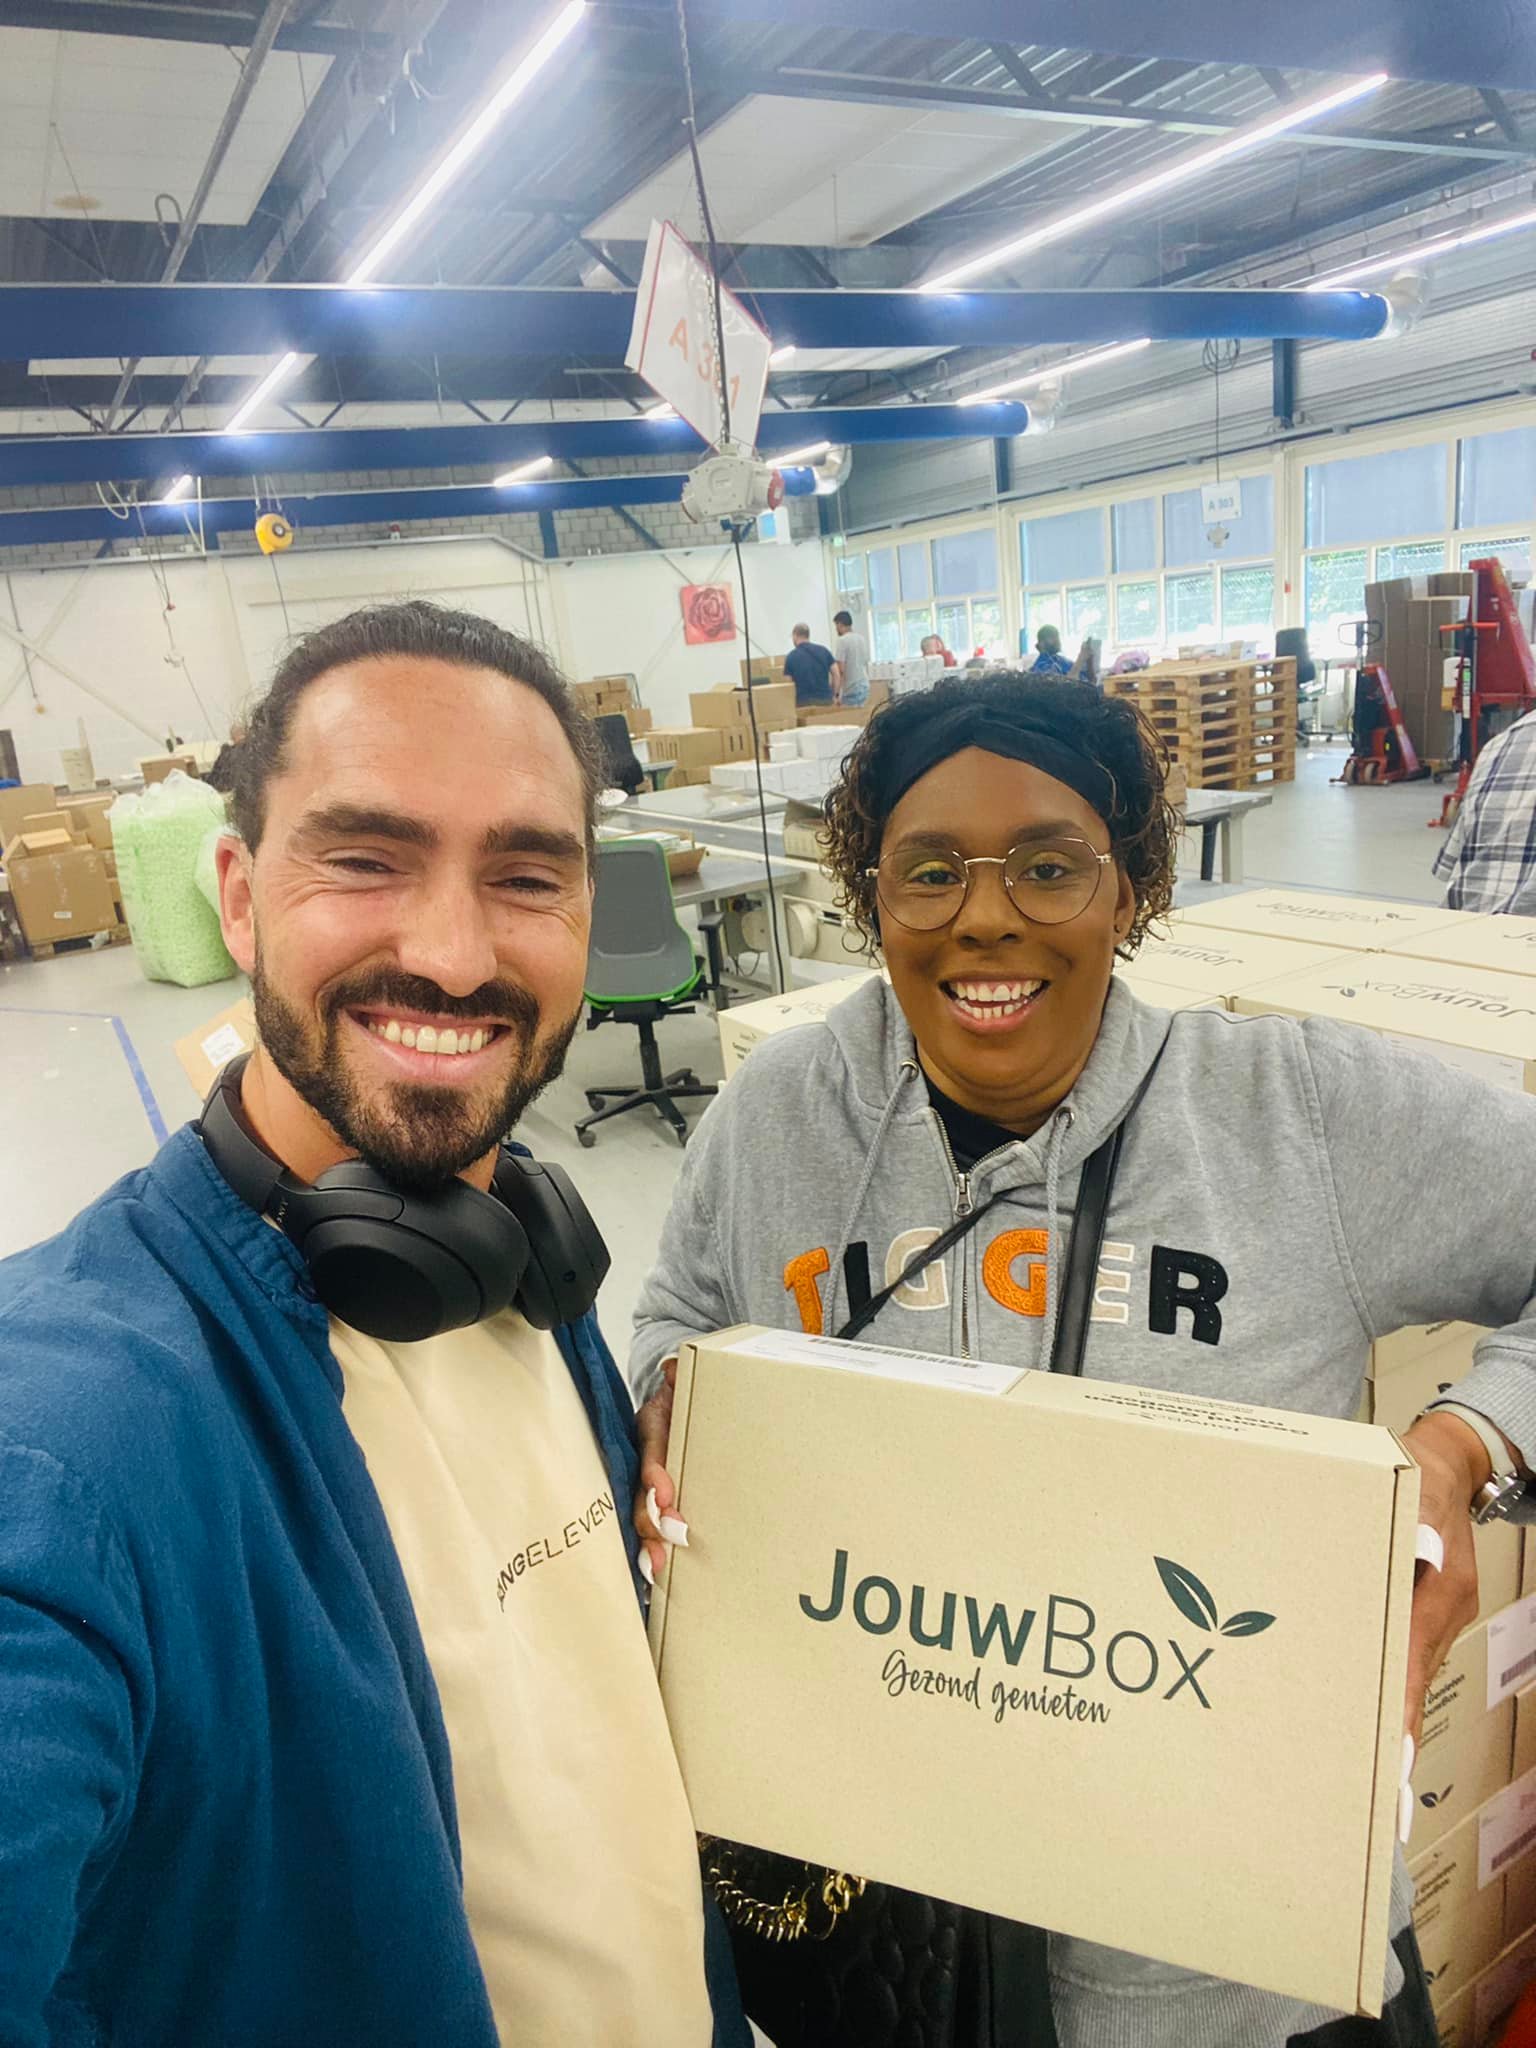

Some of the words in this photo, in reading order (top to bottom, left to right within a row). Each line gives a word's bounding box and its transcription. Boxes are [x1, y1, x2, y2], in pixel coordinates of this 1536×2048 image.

[669, 318, 689, 363] A
[783, 1227, 1229, 1346] TIGGER
[799, 1548, 1215, 1709] JouwBox
[881, 1648, 982, 1710] Gezond
[991, 1681, 1111, 1723] genieten
